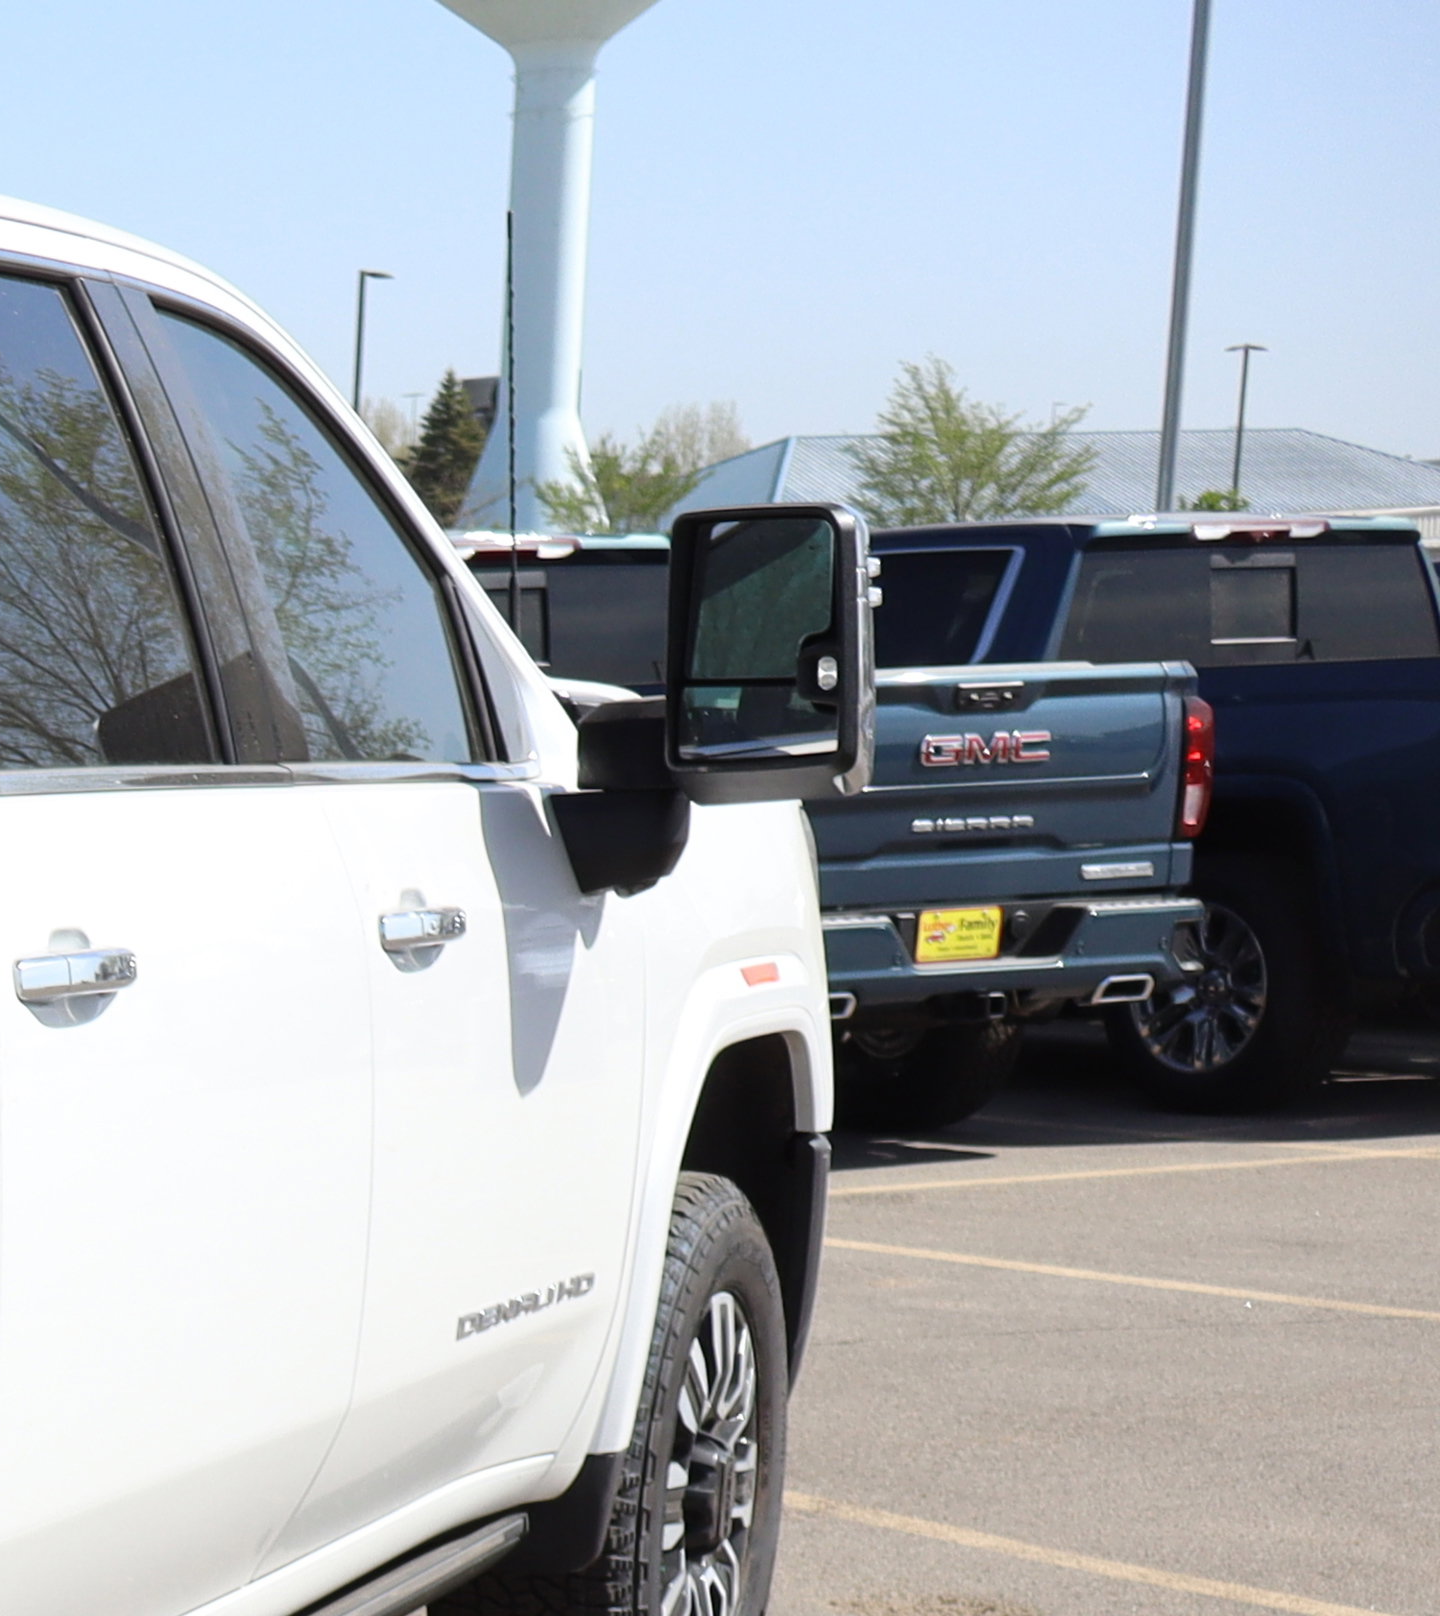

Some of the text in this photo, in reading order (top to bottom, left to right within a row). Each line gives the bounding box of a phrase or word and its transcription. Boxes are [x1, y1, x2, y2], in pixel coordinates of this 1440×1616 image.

[920, 729, 1051, 767] GMC
[456, 1271, 595, 1341] DENALI HD
